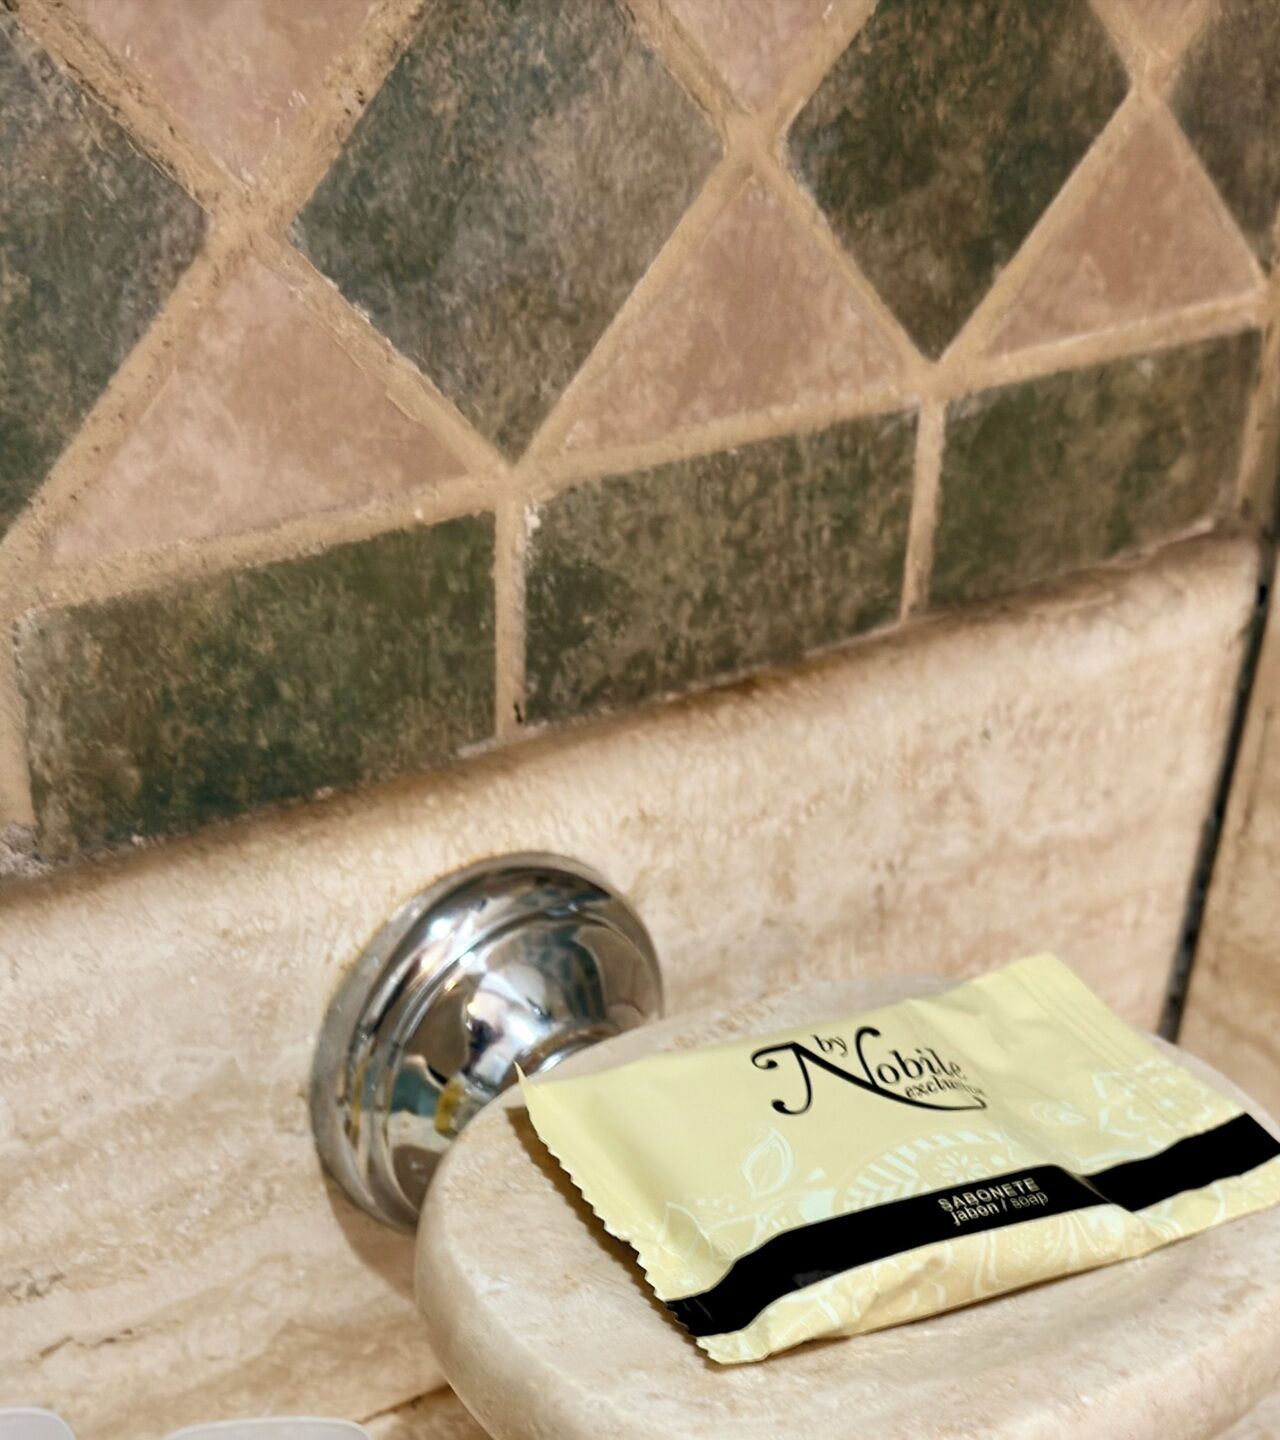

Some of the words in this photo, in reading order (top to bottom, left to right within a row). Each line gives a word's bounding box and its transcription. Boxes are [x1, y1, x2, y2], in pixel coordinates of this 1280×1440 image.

[812, 1034, 849, 1057] by
[750, 1025, 987, 1116] Nobile
[937, 1177, 1041, 1213] SABONETE
[1009, 1191, 1050, 1210] soap
